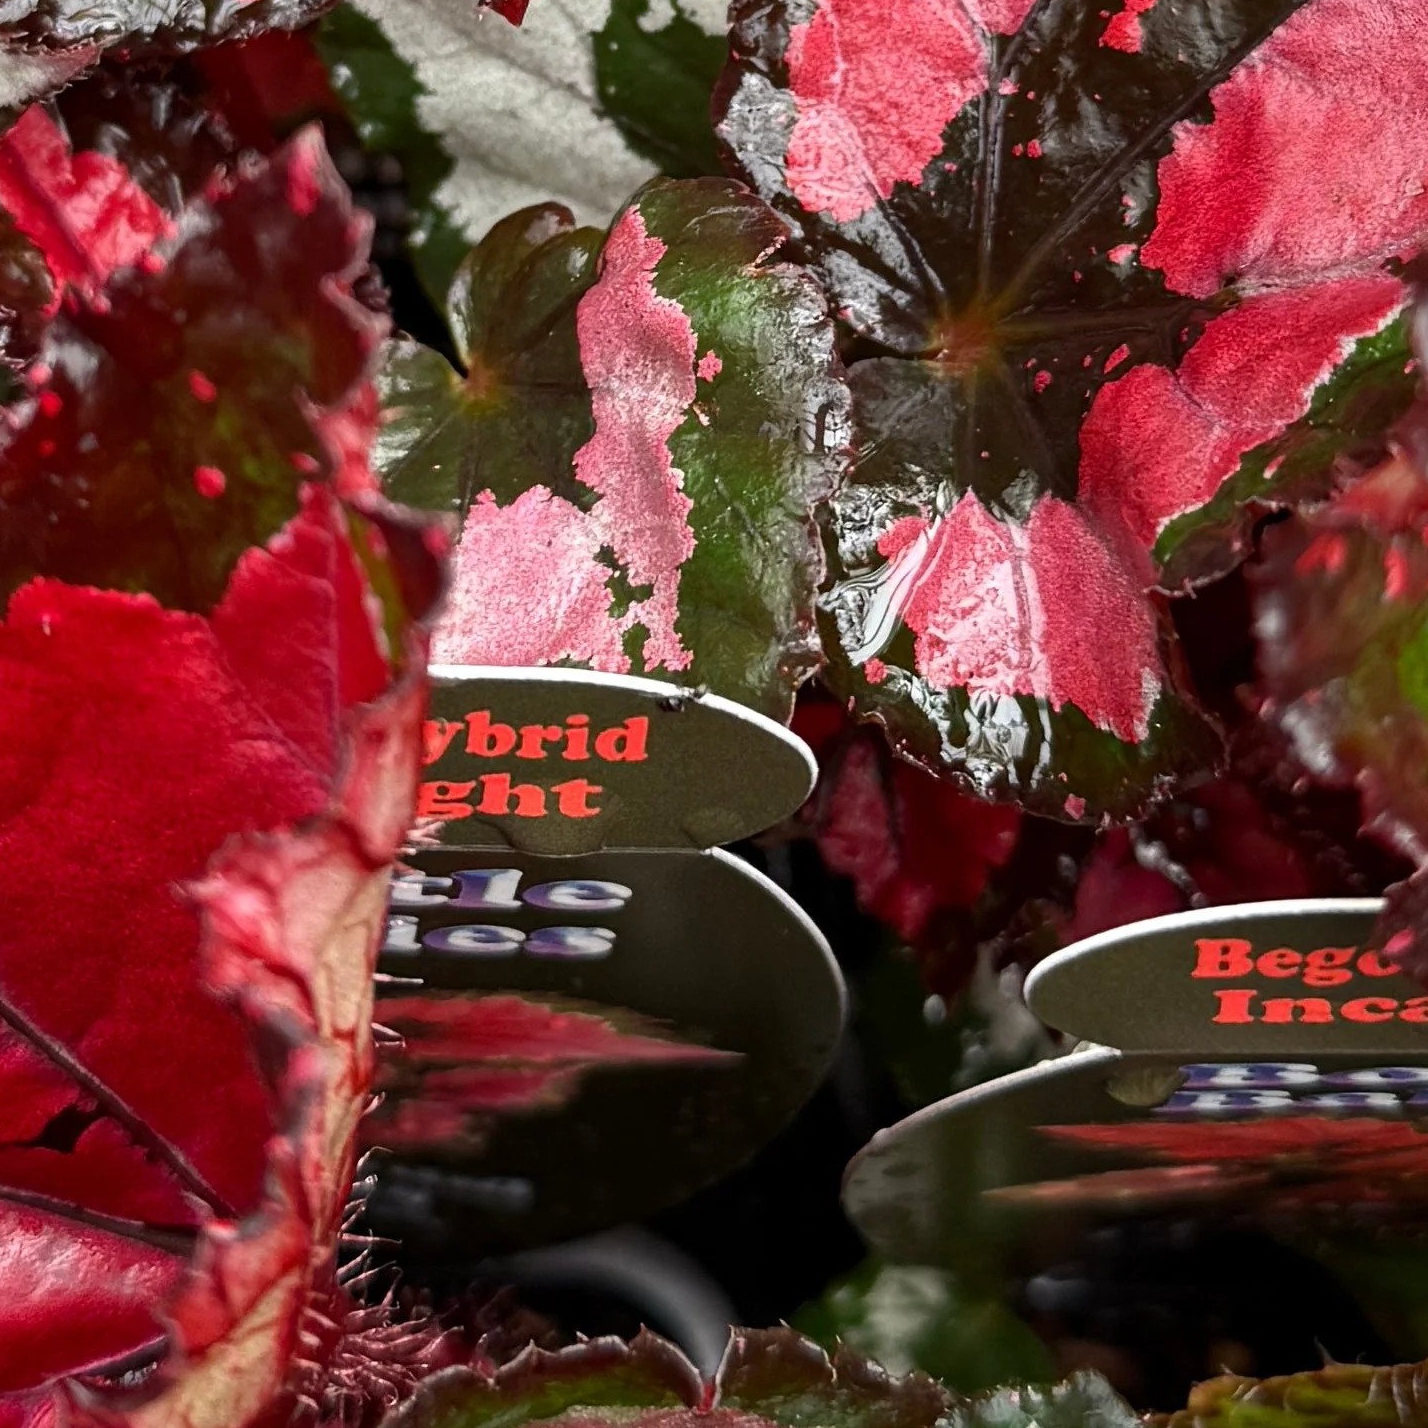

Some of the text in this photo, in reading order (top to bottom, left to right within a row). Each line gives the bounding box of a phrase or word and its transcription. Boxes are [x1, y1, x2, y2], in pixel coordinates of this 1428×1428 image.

[421, 710, 649, 766] ybrid
[417, 773, 604, 820] ght
[390, 869, 633, 911] tle
[384, 916, 617, 956] ies
[1191, 938, 1402, 987] Bego
